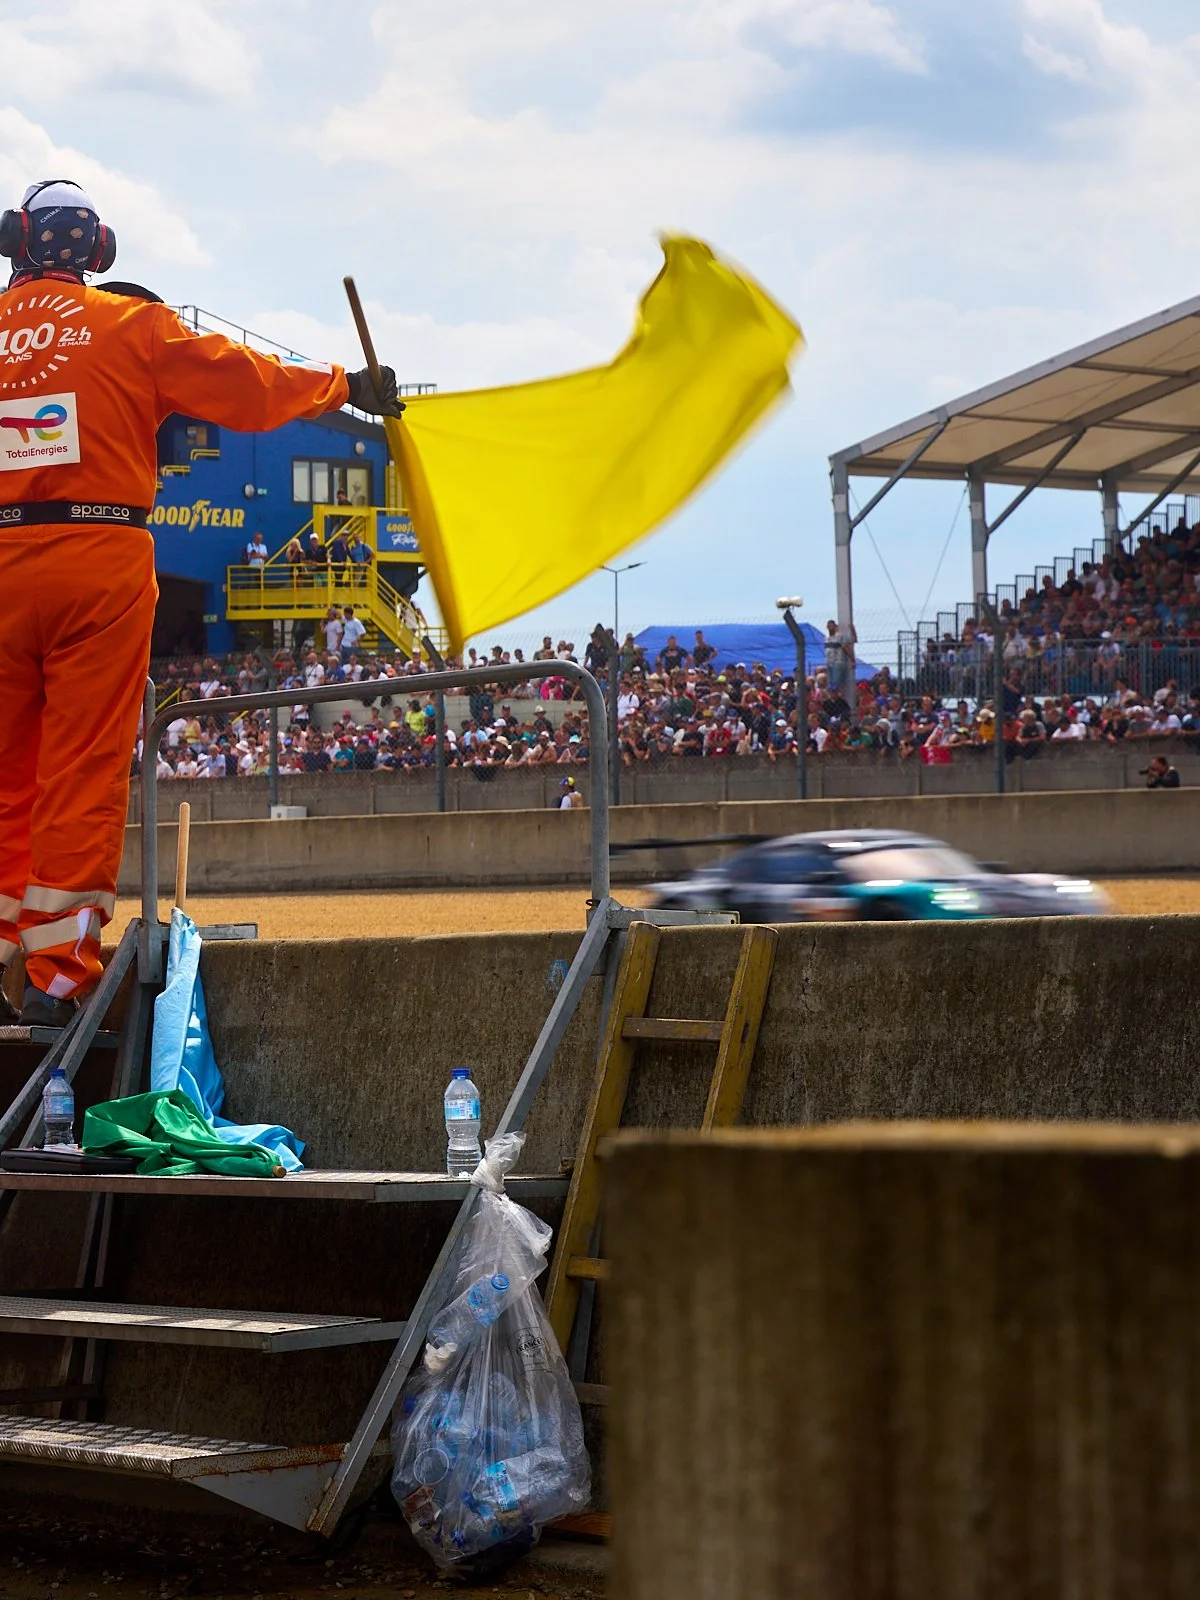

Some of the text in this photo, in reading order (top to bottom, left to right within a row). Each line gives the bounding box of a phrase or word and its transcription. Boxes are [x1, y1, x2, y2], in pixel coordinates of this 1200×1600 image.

[5, 352, 32, 364] ANS
[6, 444, 68, 458] TotalEnergies
[71, 504, 130, 519] sparco
